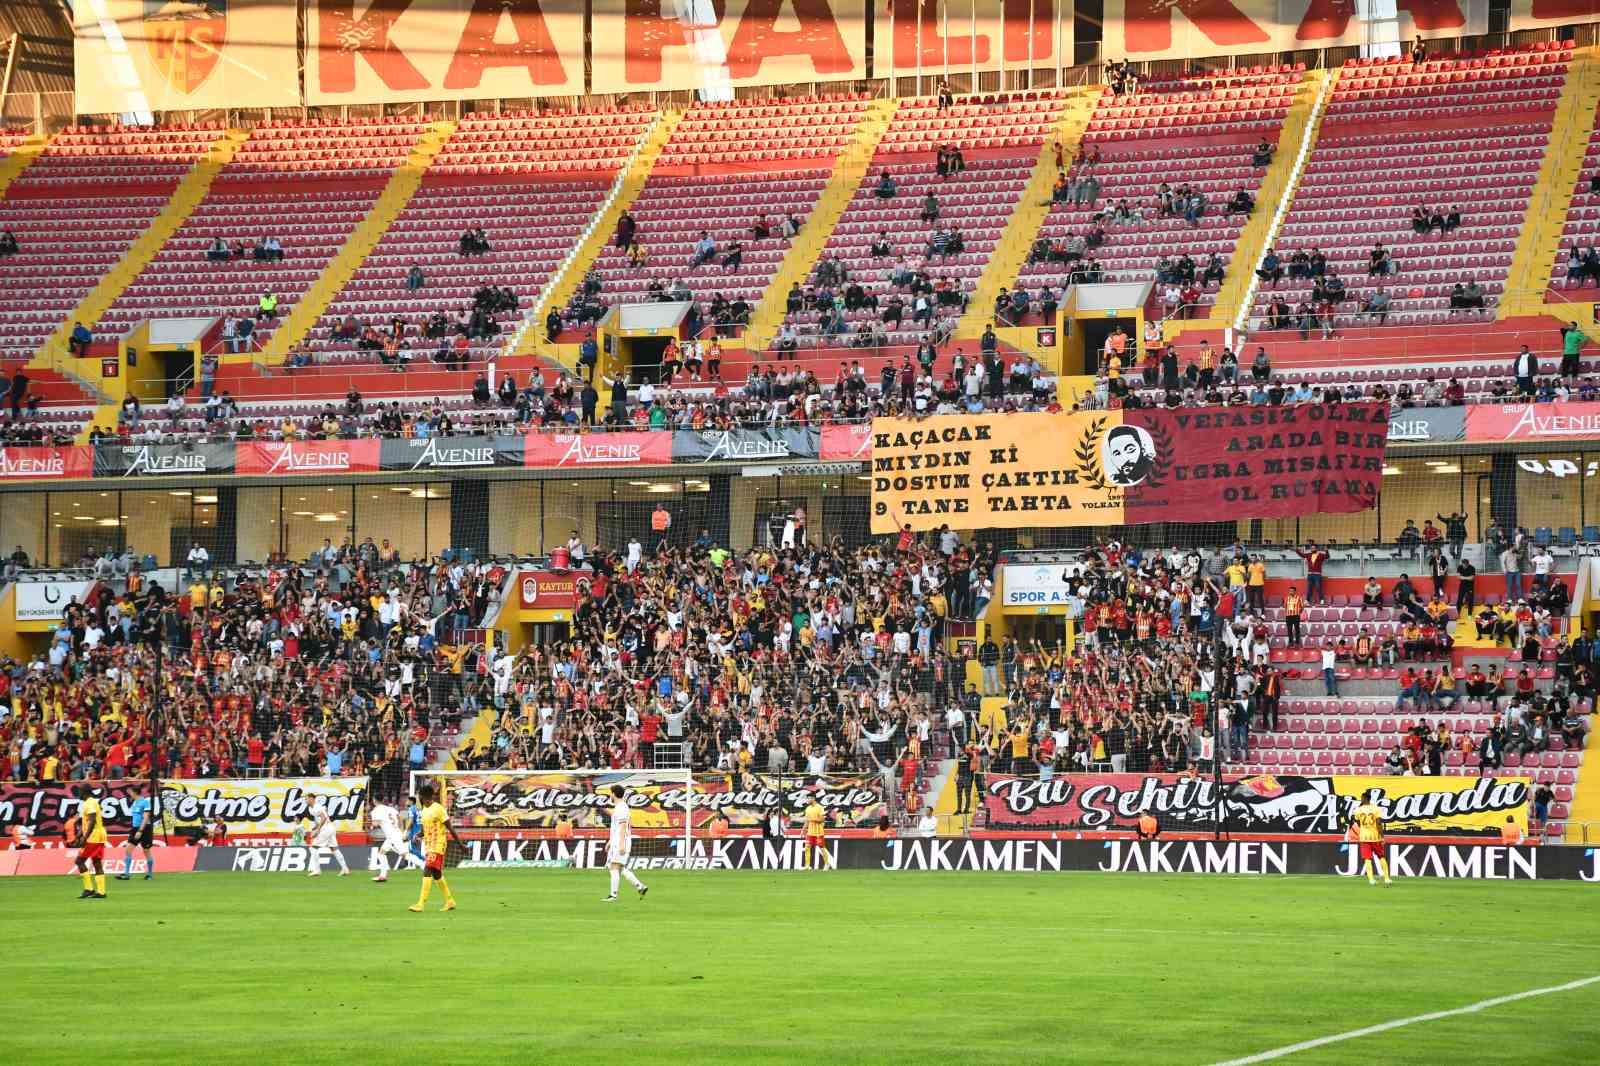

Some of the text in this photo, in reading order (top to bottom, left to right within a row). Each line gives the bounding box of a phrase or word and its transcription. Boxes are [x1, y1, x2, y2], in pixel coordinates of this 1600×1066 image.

[1308, 404, 1387, 424] OLMA
[704, 431, 788, 464] AVENIR
[874, 425, 991, 450] KAÇACAK
[1227, 430, 1323, 452] ARADA
[124, 446, 206, 477] AVENIR
[268, 442, 349, 474] AVENIR
[411, 438, 494, 472] AVENIR
[557, 435, 640, 467] AVENIR
[875, 443, 1019, 473] MIYDIN Kİ
[875, 469, 1079, 493] DOSTUM ÇAKTIK
[1223, 486, 1259, 501] OL
[875, 495, 1072, 515] 9 TANE TAHTA
[1082, 501, 1120, 509] VOLKAN
[539, 582, 574, 592] KAYTUR
[1010, 591, 1046, 602] SPOR
[178, 789, 269, 819] etme
[519, 786, 649, 808] Aleme
[1360, 813, 1376, 825] 23
[469, 840, 612, 869] JAKAME
[880, 840, 1062, 872] JAKAMEN
[1098, 841, 1288, 874] JAKAMEN
